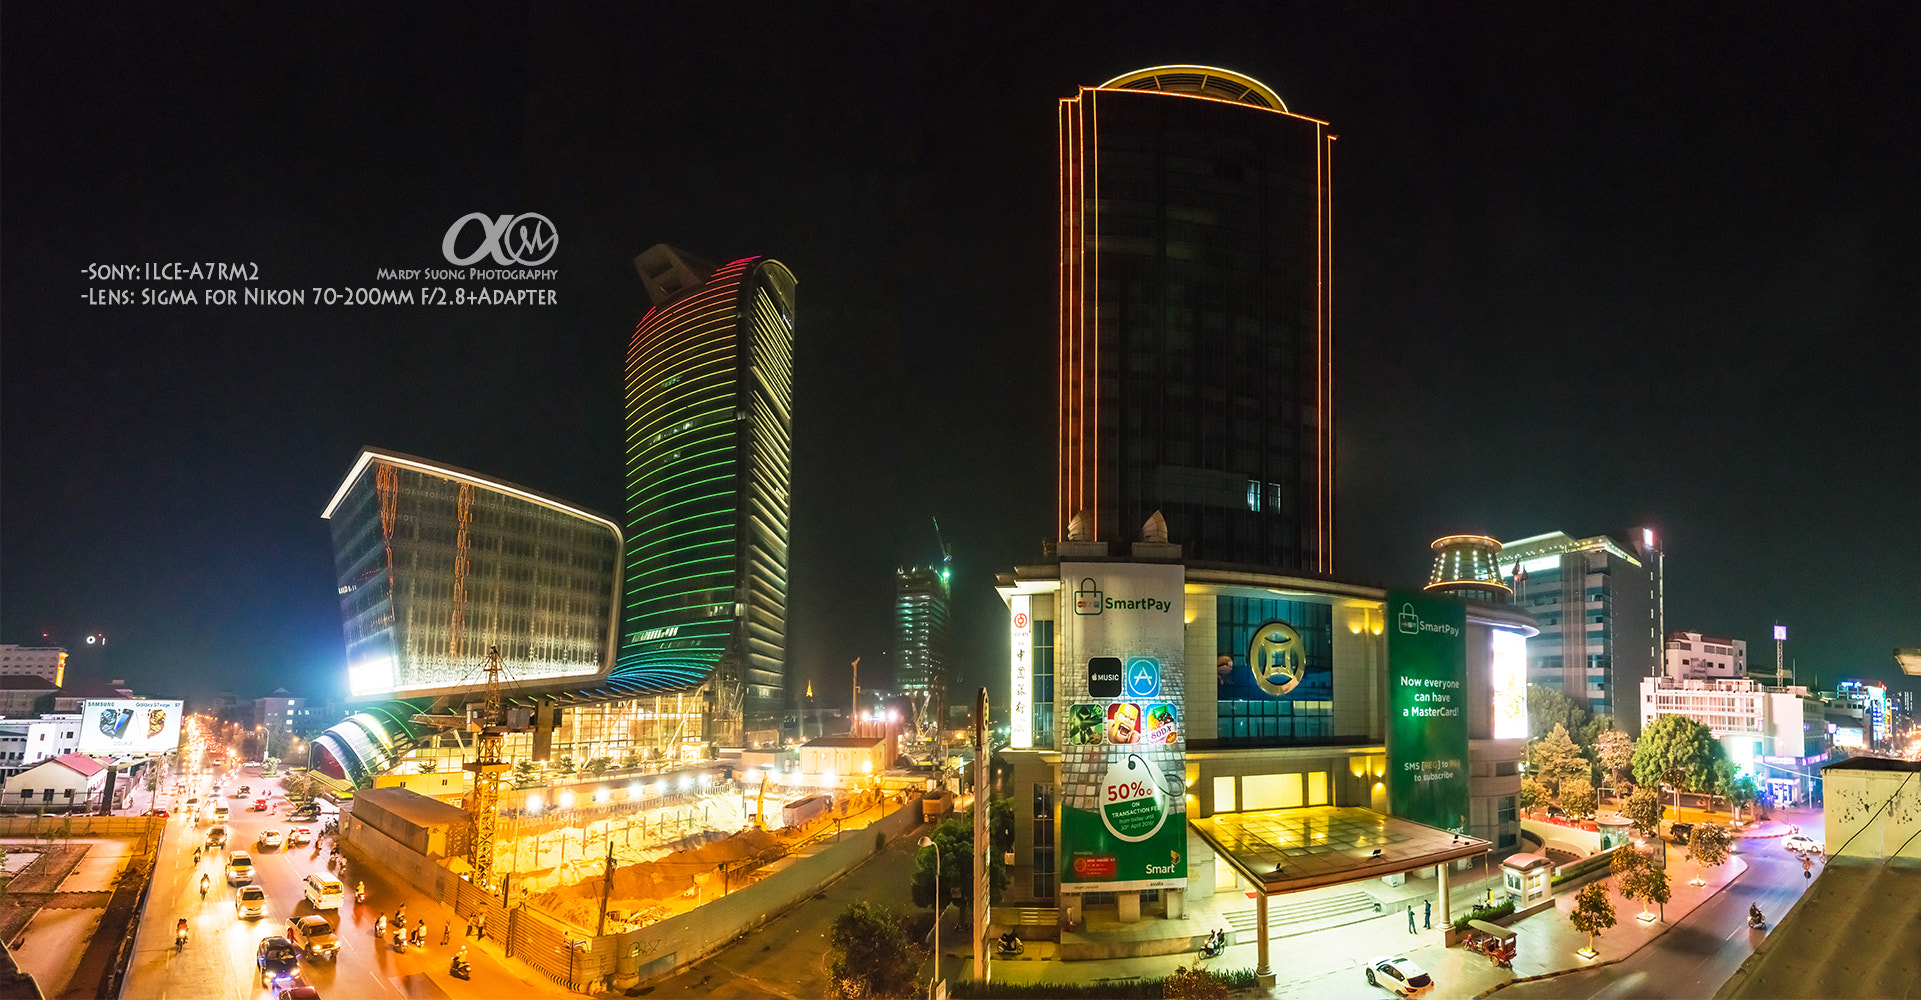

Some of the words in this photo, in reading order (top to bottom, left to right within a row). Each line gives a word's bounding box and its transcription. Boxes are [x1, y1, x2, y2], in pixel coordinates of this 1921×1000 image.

[1105, 597, 1171, 613] SmartPay
[1420, 621, 1459, 637] SmartPay
[1097, 673, 1120, 681] MUSIC
[1401, 676, 1422, 687] Now
[1424, 679, 1460, 690] everyone
[1414, 693, 1430, 702] can
[1432, 692, 1451, 703] have
[1403, 708, 1409, 717] a
[1411, 706, 1460, 717] MasterCard!
[1404, 762, 1420, 771] SMS
[1414, 774, 1422, 782] to
[1423, 771, 1454, 781] subscribe
[1112, 808, 1150, 818] TRANSACTION
[1145, 863, 1175, 875] Smart
